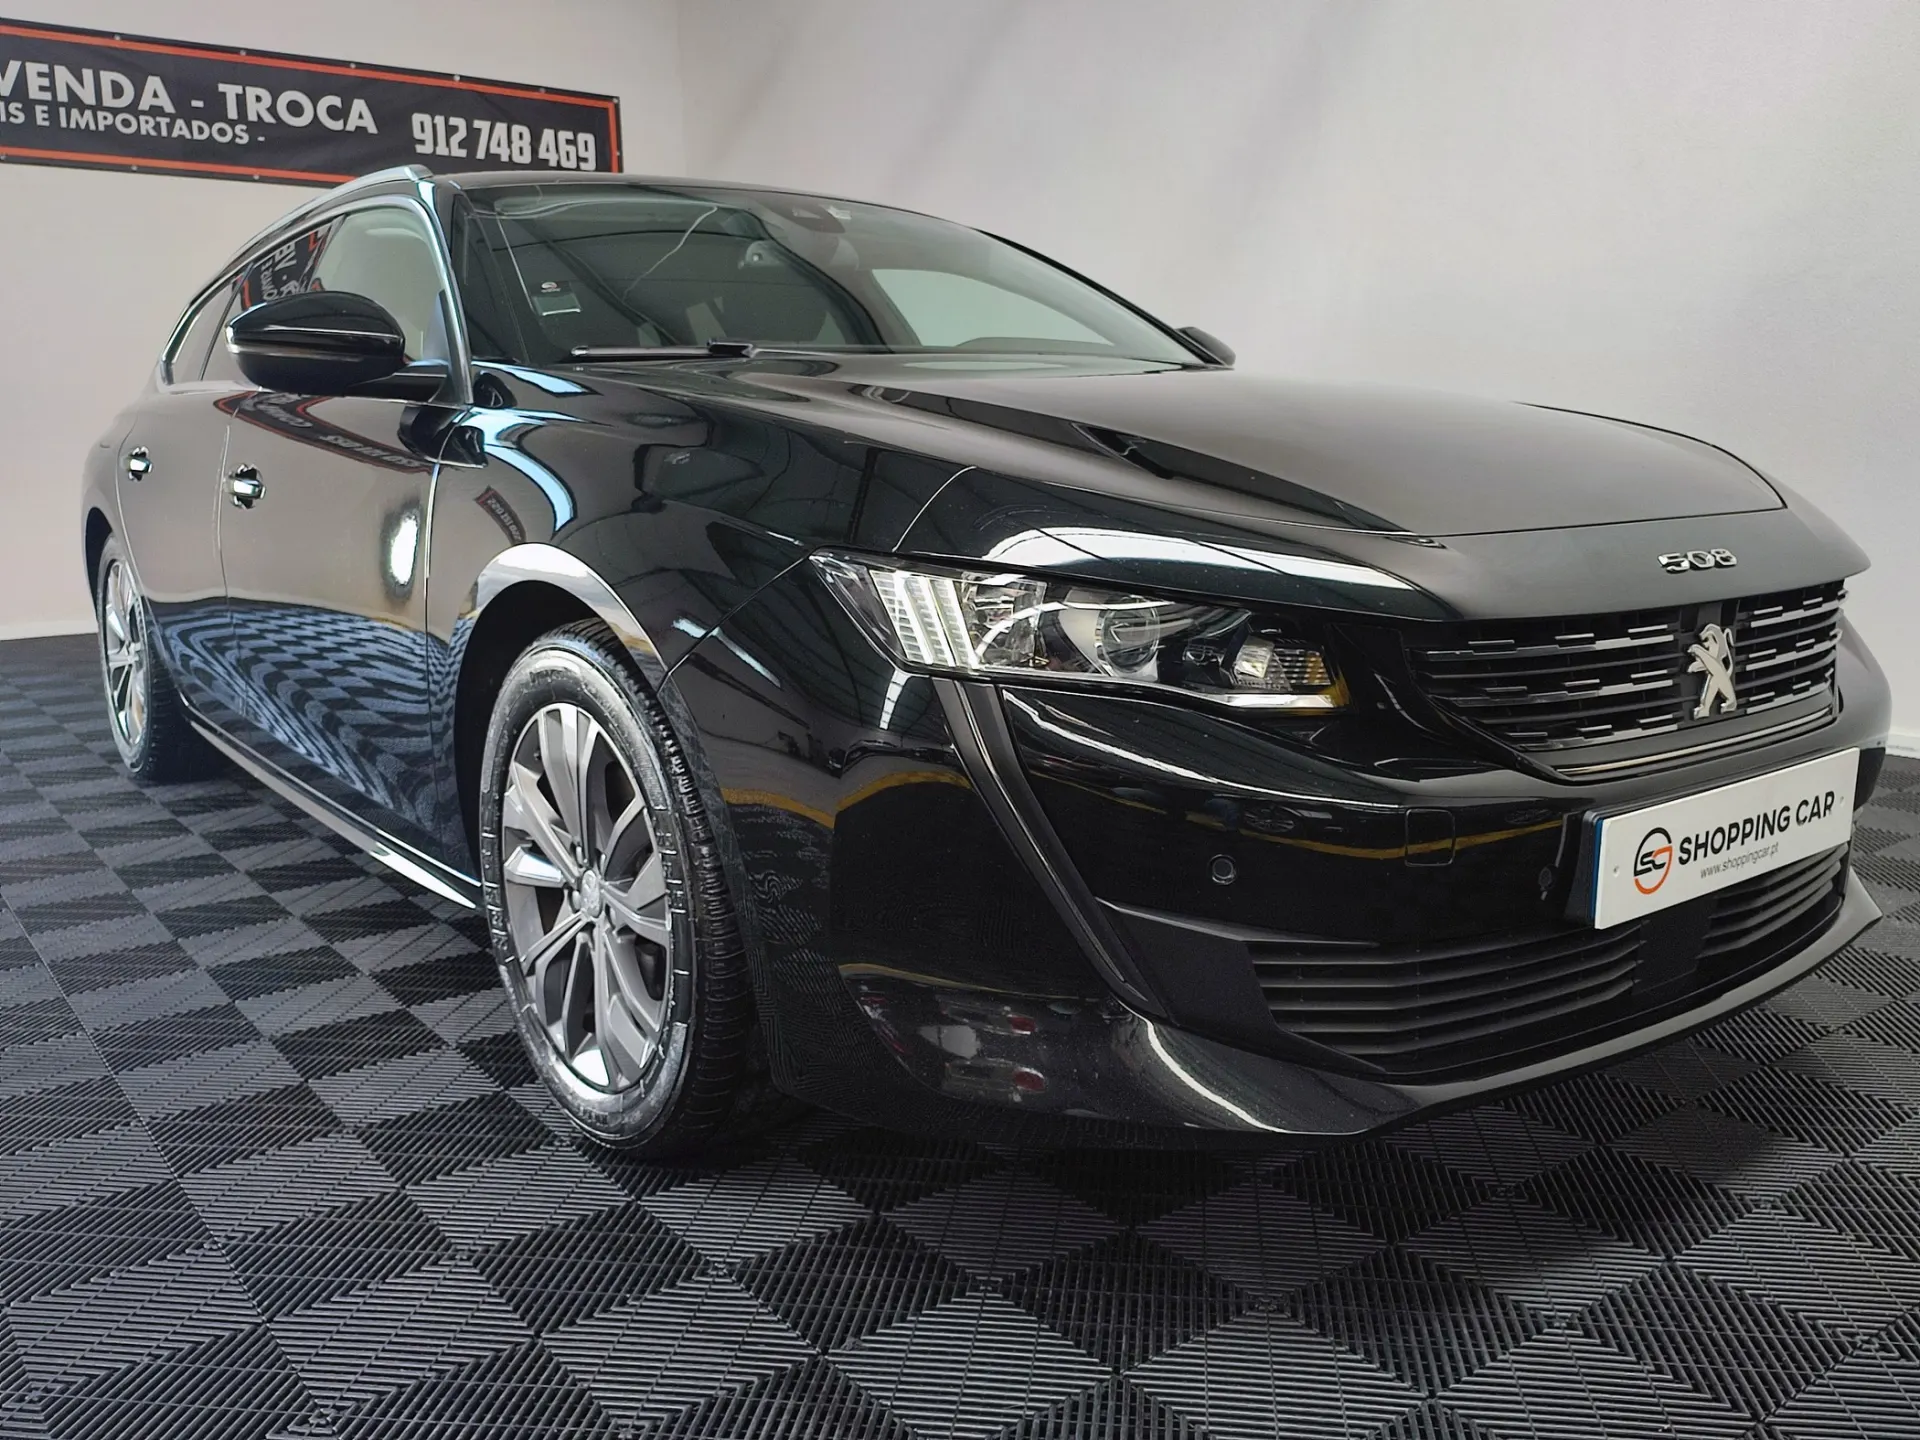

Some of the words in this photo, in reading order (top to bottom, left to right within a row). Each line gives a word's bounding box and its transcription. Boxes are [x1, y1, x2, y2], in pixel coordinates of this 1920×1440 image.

[0, 60, 176, 113] VENDA
[217, 82, 379, 134] TROCA
[35, 104, 50, 127] E
[58, 106, 250, 145] IMPORTADOS
[411, 112, 468, 158] 912
[473, 119, 532, 164] 748
[538, 128, 597, 171] 469
[1657, 548, 1738, 573] 508
[1678, 804, 1791, 866] SHOPPING
[1795, 790, 1835, 827] CAR
[1700, 841, 1780, 879] www.shoppingcar.pt
